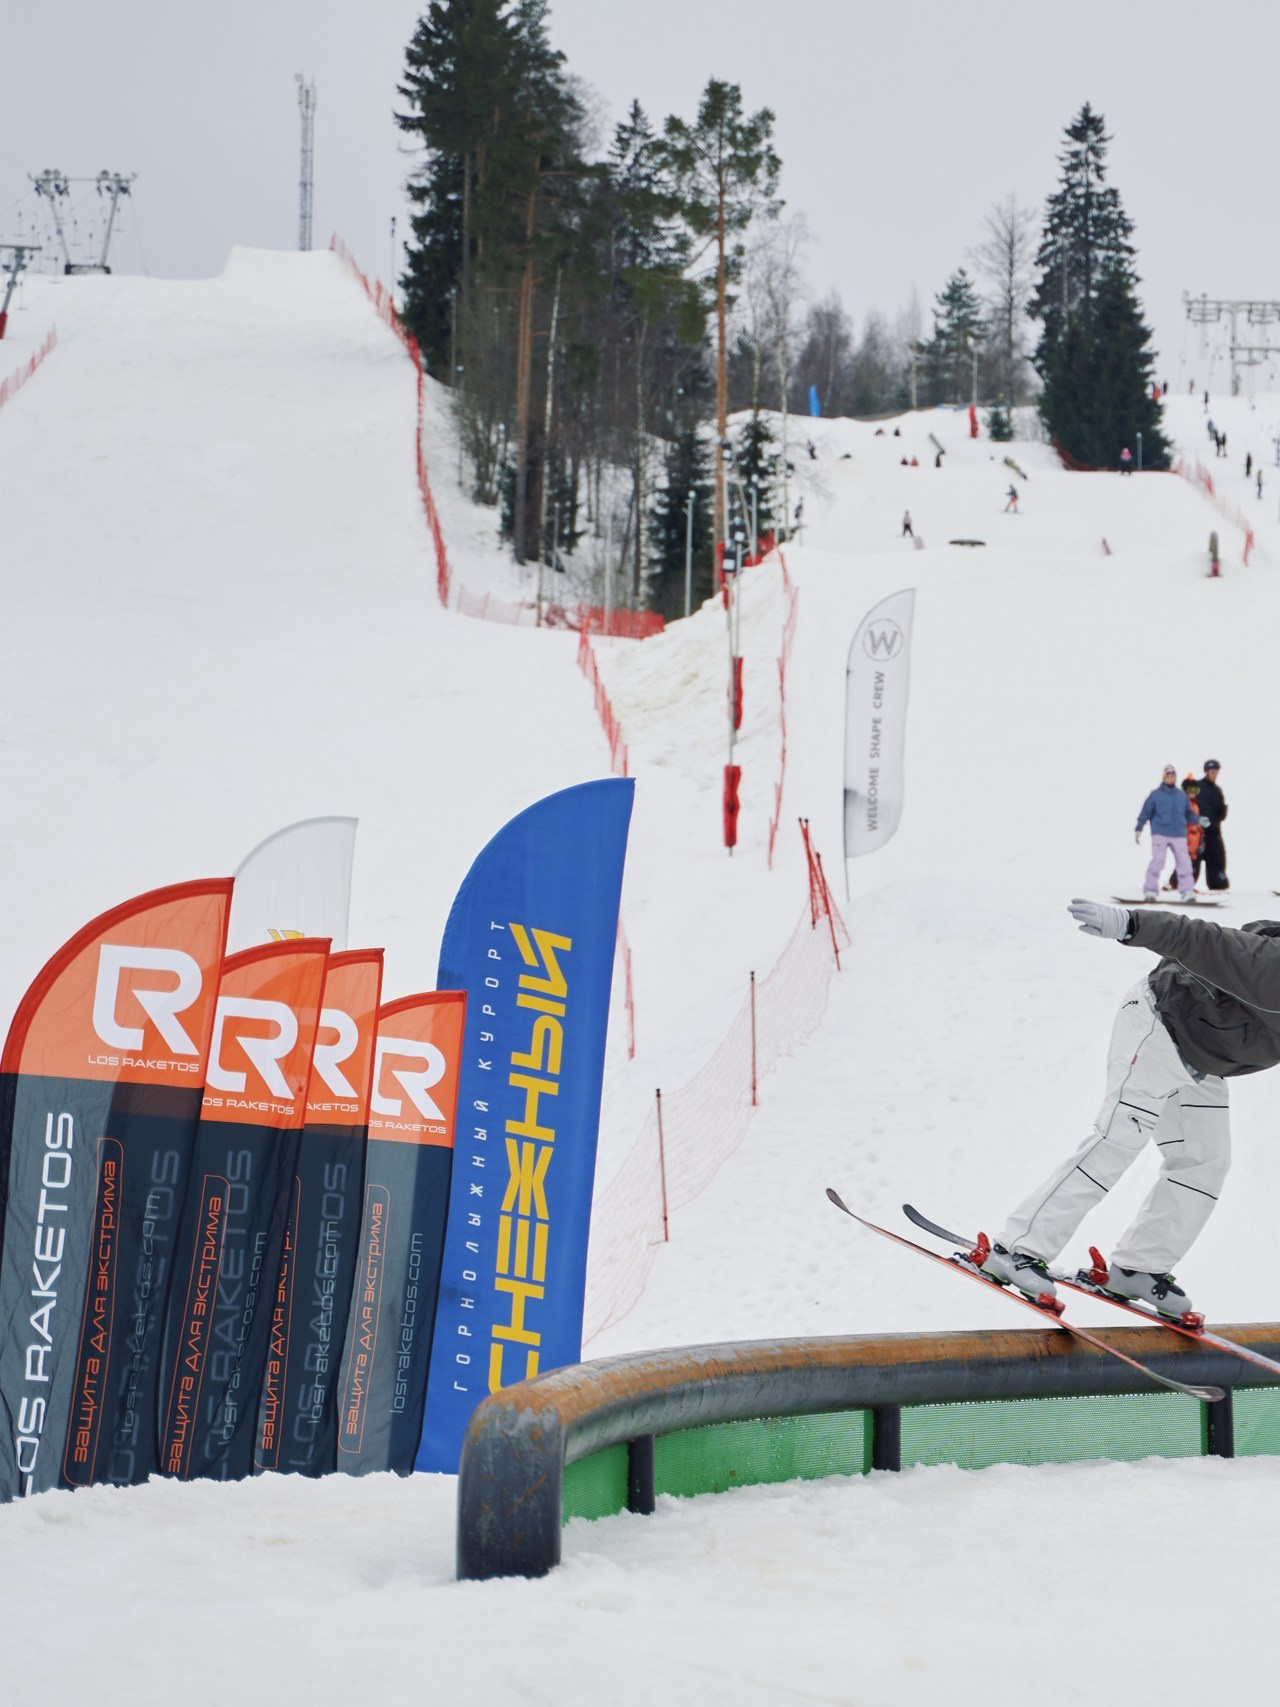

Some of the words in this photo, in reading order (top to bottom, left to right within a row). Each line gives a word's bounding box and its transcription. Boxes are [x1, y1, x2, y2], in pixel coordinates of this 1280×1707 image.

[872, 670, 885, 709] CREW
[869, 716, 882, 759] SHAPE
[867, 766, 880, 833] WELCOME
[87, 1054, 120, 1067] LOS
[122, 1057, 200, 1073] RAKETOS
[203, 1097, 223, 1107] OS
[226, 1099, 295, 1115] RAKETOS
[306, 1103, 359, 1113] AKETOS
[369, 1120, 383, 1129] OS
[385, 1121, 447, 1135] RAKETOS
[453, 1099, 490, 1393] ГОРНОЛЫЖНЫЙ
[477, 920, 505, 1071] КУРОРТ
[24, 1111, 74, 1383] RAKETOS
[308, 1220, 338, 1424] losraketos.com
[390, 1232, 424, 1415] losraketos.com
